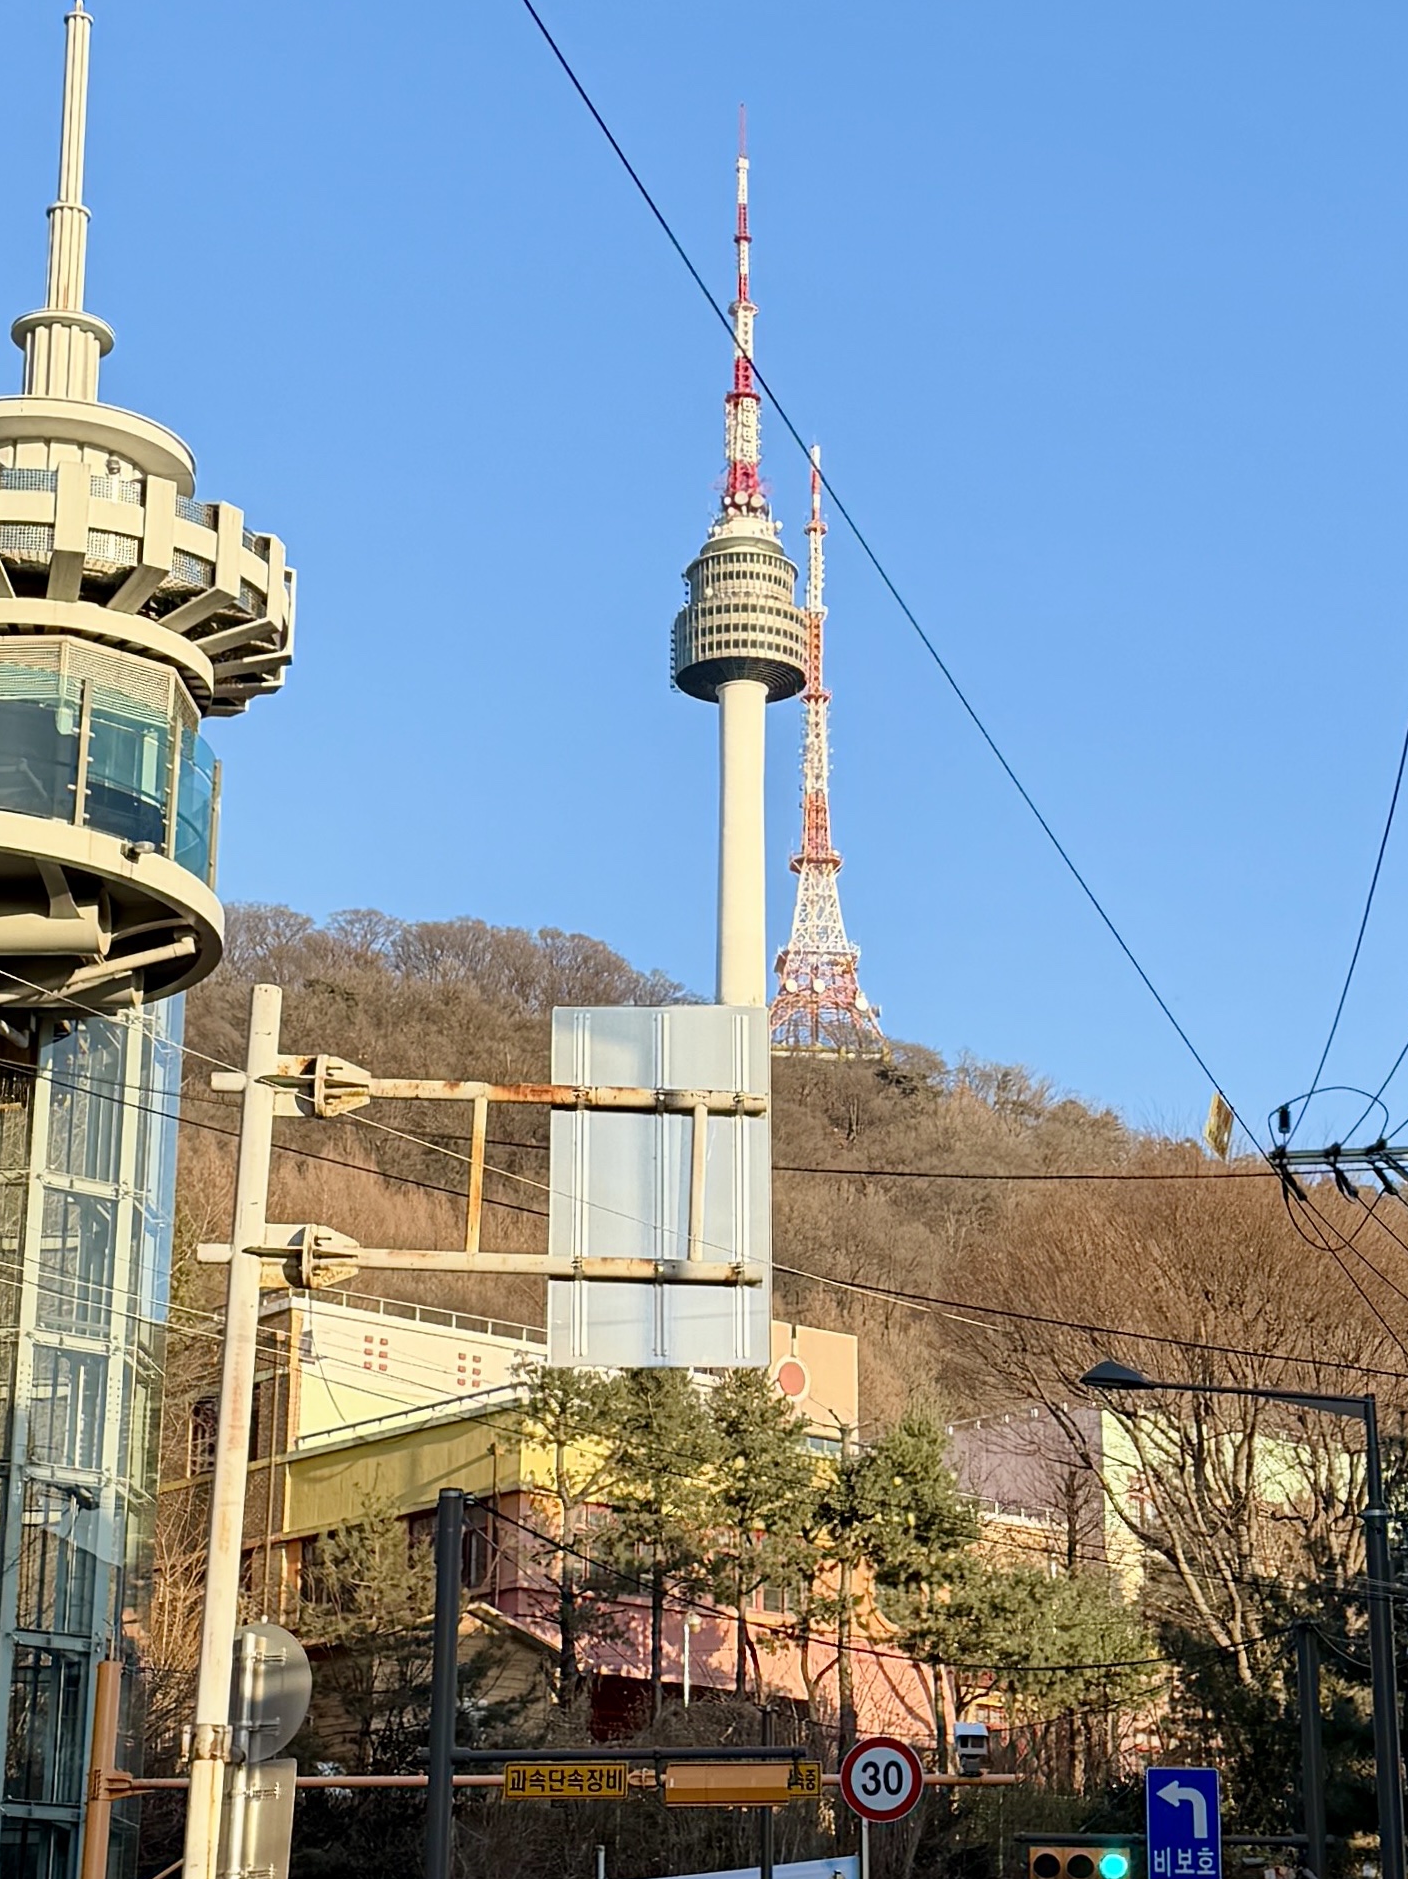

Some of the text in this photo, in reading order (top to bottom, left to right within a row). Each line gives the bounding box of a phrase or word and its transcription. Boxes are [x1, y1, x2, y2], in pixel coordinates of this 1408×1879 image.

[509, 1768, 623, 1793] 과속단속장비
[860, 1760, 904, 1797] 30
[1153, 1846, 1217, 1878] 비보호
